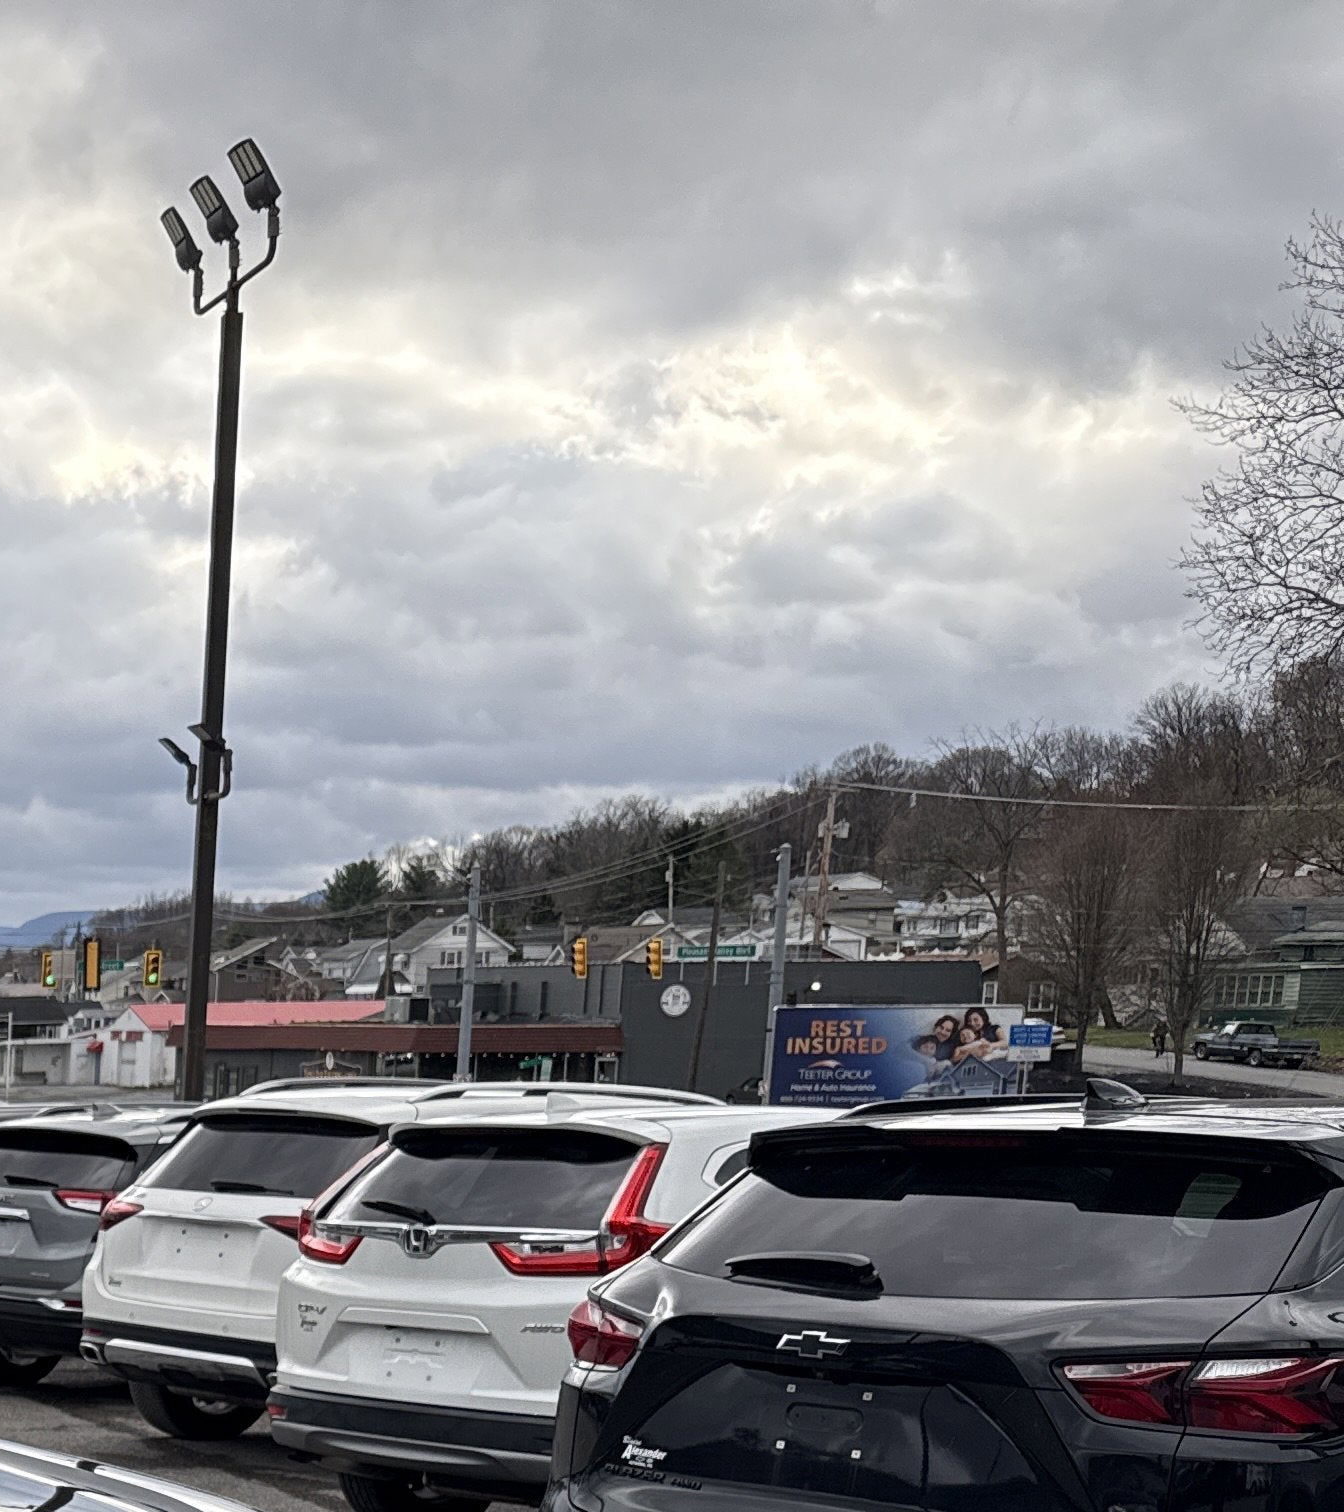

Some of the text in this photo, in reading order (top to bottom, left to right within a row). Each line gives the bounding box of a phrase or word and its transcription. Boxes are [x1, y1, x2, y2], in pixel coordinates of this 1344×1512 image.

[810, 1020, 867, 1037] REST
[786, 1037, 888, 1055] INSURED
[790, 1084, 812, 1092] Home
[820, 1084, 839, 1092] Auto
[839, 1084, 877, 1092] Insurance
[620, 1444, 668, 1461] Alexander
